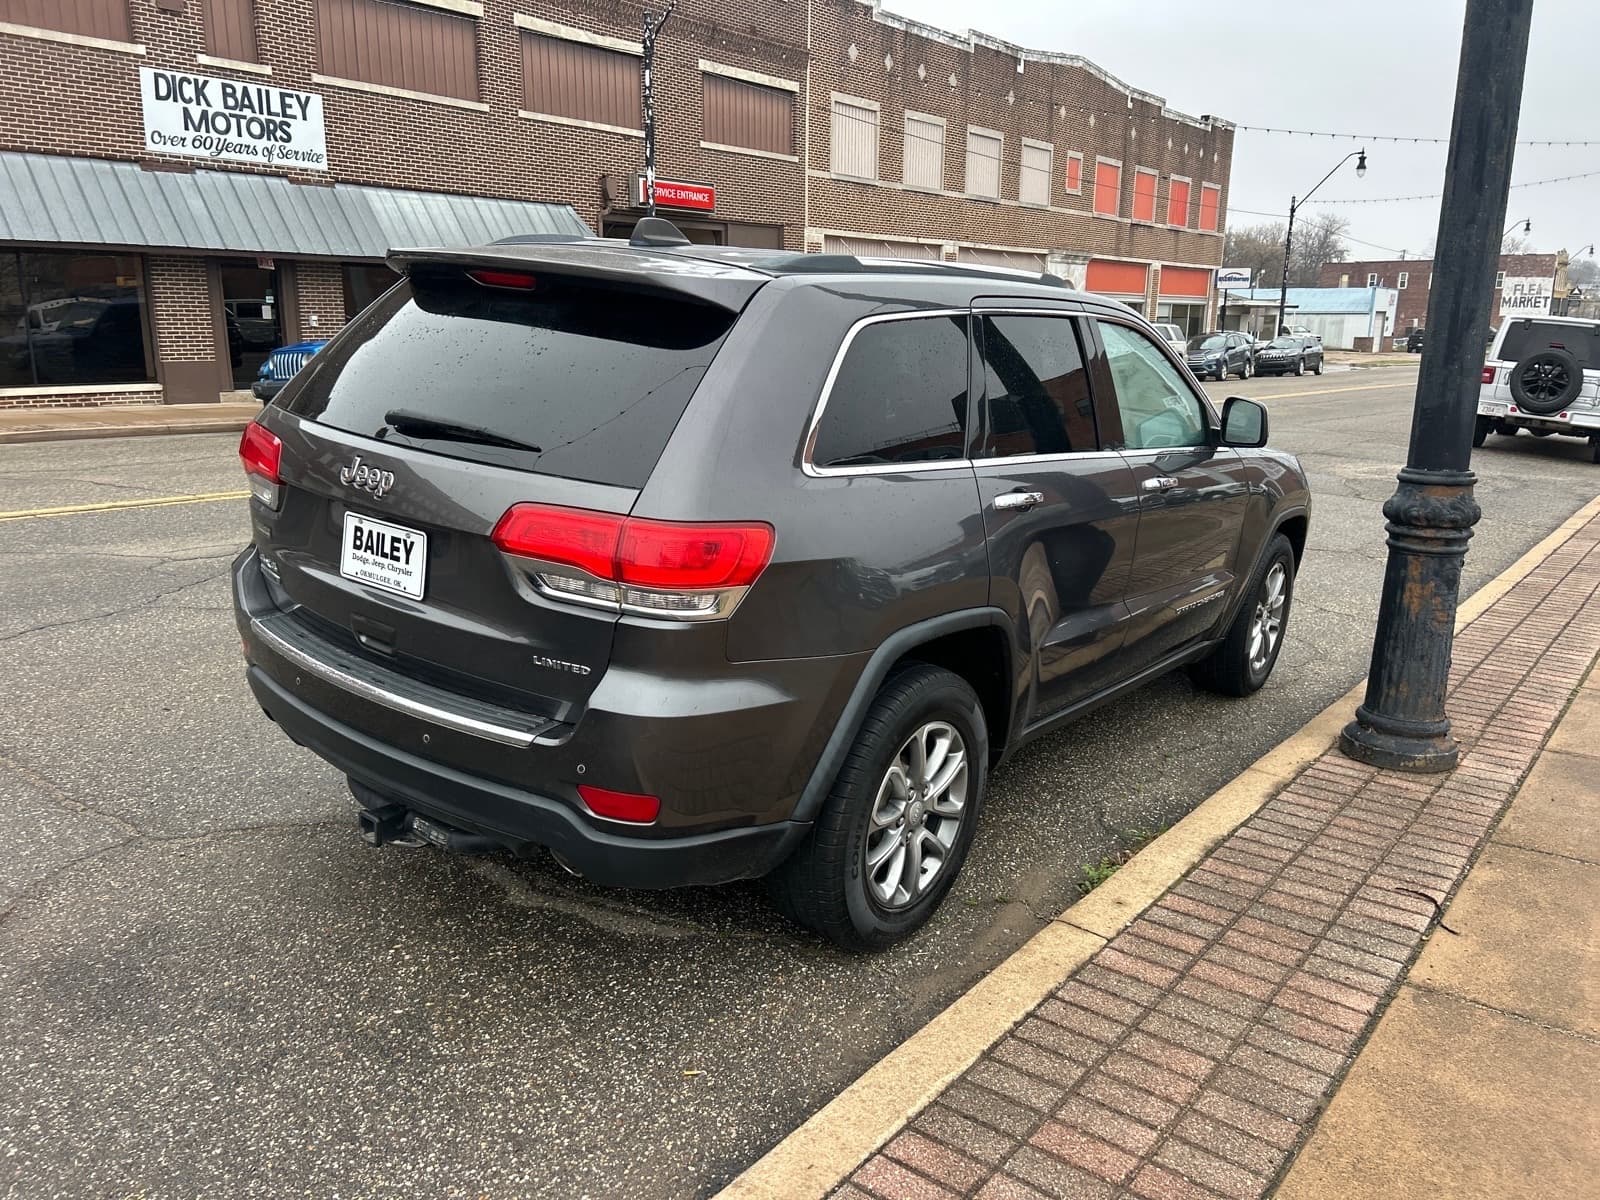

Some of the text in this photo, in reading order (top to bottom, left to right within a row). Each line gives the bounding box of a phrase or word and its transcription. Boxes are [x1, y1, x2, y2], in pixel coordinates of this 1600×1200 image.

[153, 72, 311, 121] DICK BAILEY
[182, 107, 292, 143] MOTORS
[150, 130, 325, 163] Over 60 Years of Service
[654, 187, 710, 202] ERVICE ENTRANCE
[1502, 296, 1550, 308] MARKET
[1513, 284, 1543, 296] FLEA
[341, 455, 394, 500] Jeep
[353, 525, 415, 565] BAILEY
[387, 563, 413, 577] Chrysler
[533, 655, 591, 675] LIMITED
